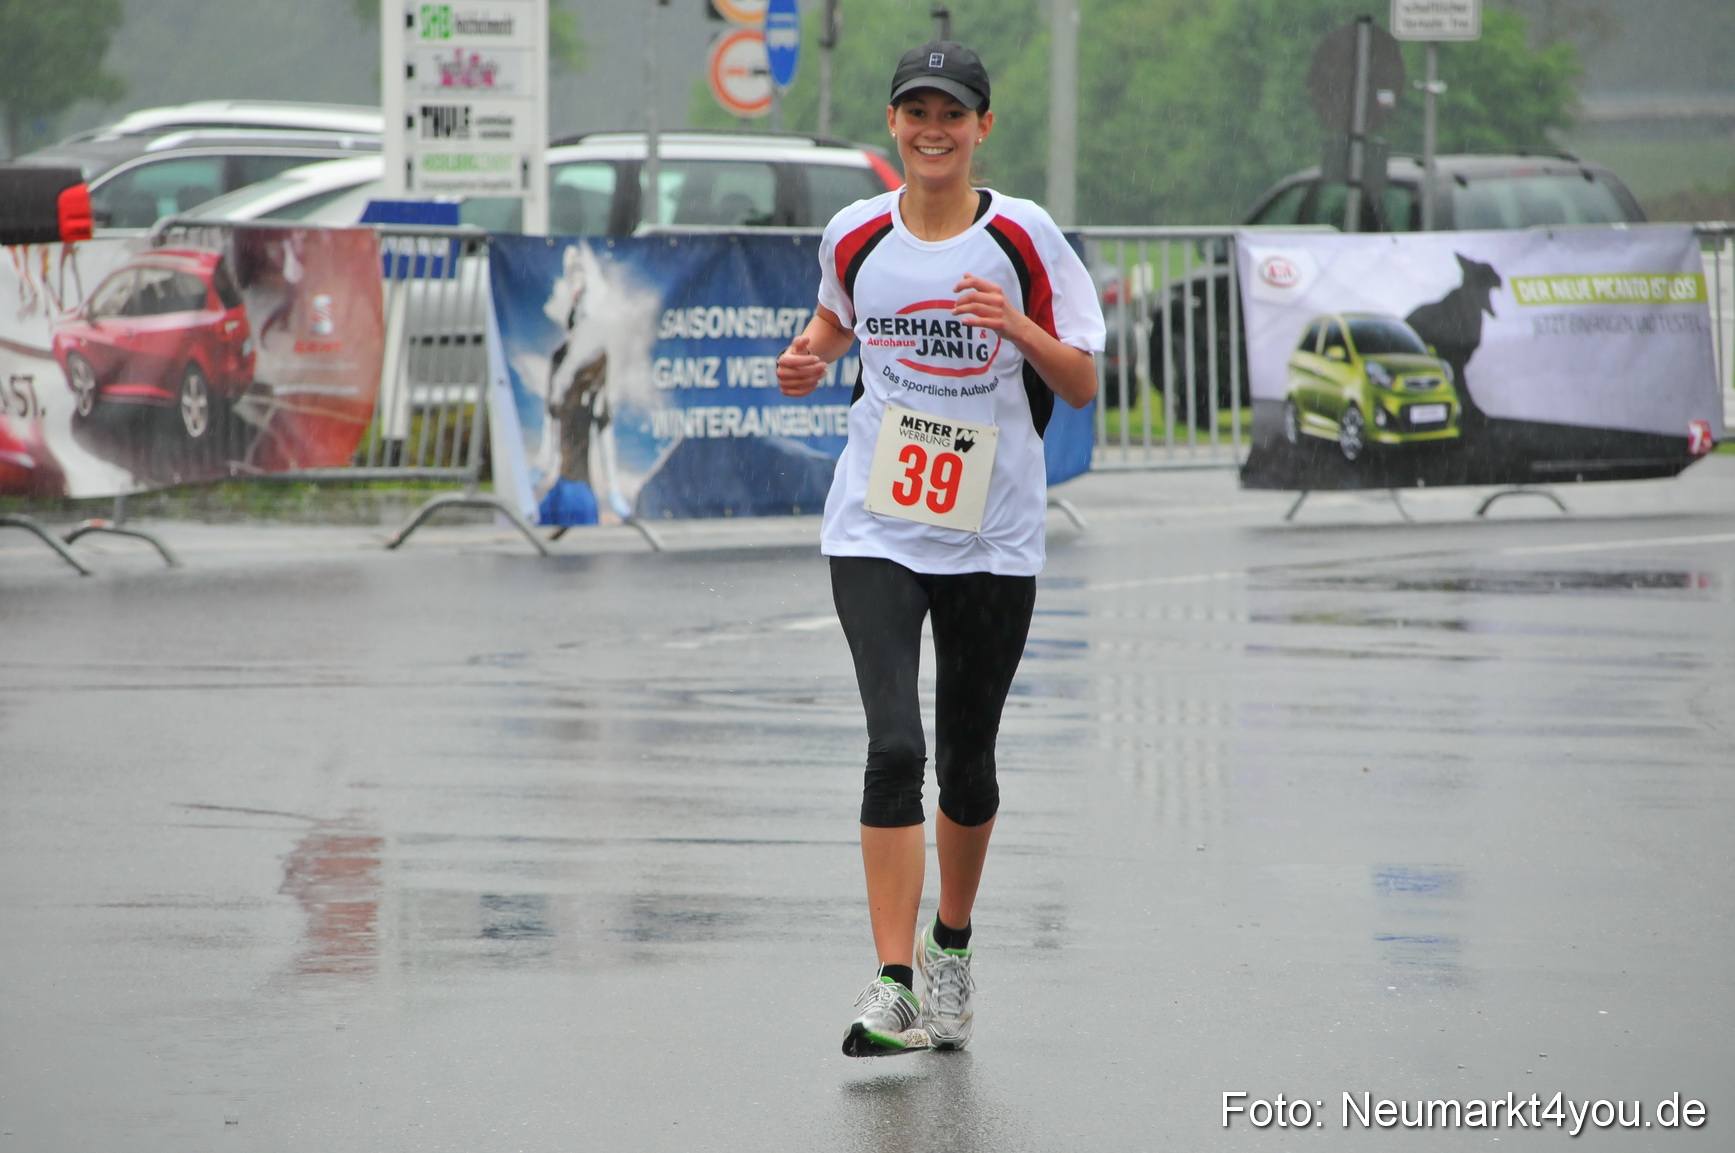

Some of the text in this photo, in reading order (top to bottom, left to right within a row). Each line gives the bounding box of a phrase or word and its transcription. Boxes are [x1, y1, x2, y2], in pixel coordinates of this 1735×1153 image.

[1517, 280, 1551, 302] DER
[1551, 278, 1594, 301] NEUE
[1593, 277, 1650, 300] PICANTO
[658, 305, 810, 340] SAISONSTART
[865, 317, 987, 341] GERHART &
[867, 337, 916, 347] Autohaus
[653, 356, 721, 389] GANZ
[882, 365, 901, 384] Das
[901, 379, 958, 397] sportliche
[898, 427, 951, 448] WERBUNG
[900, 415, 953, 438] MEYER
[891, 444, 964, 514] 39
